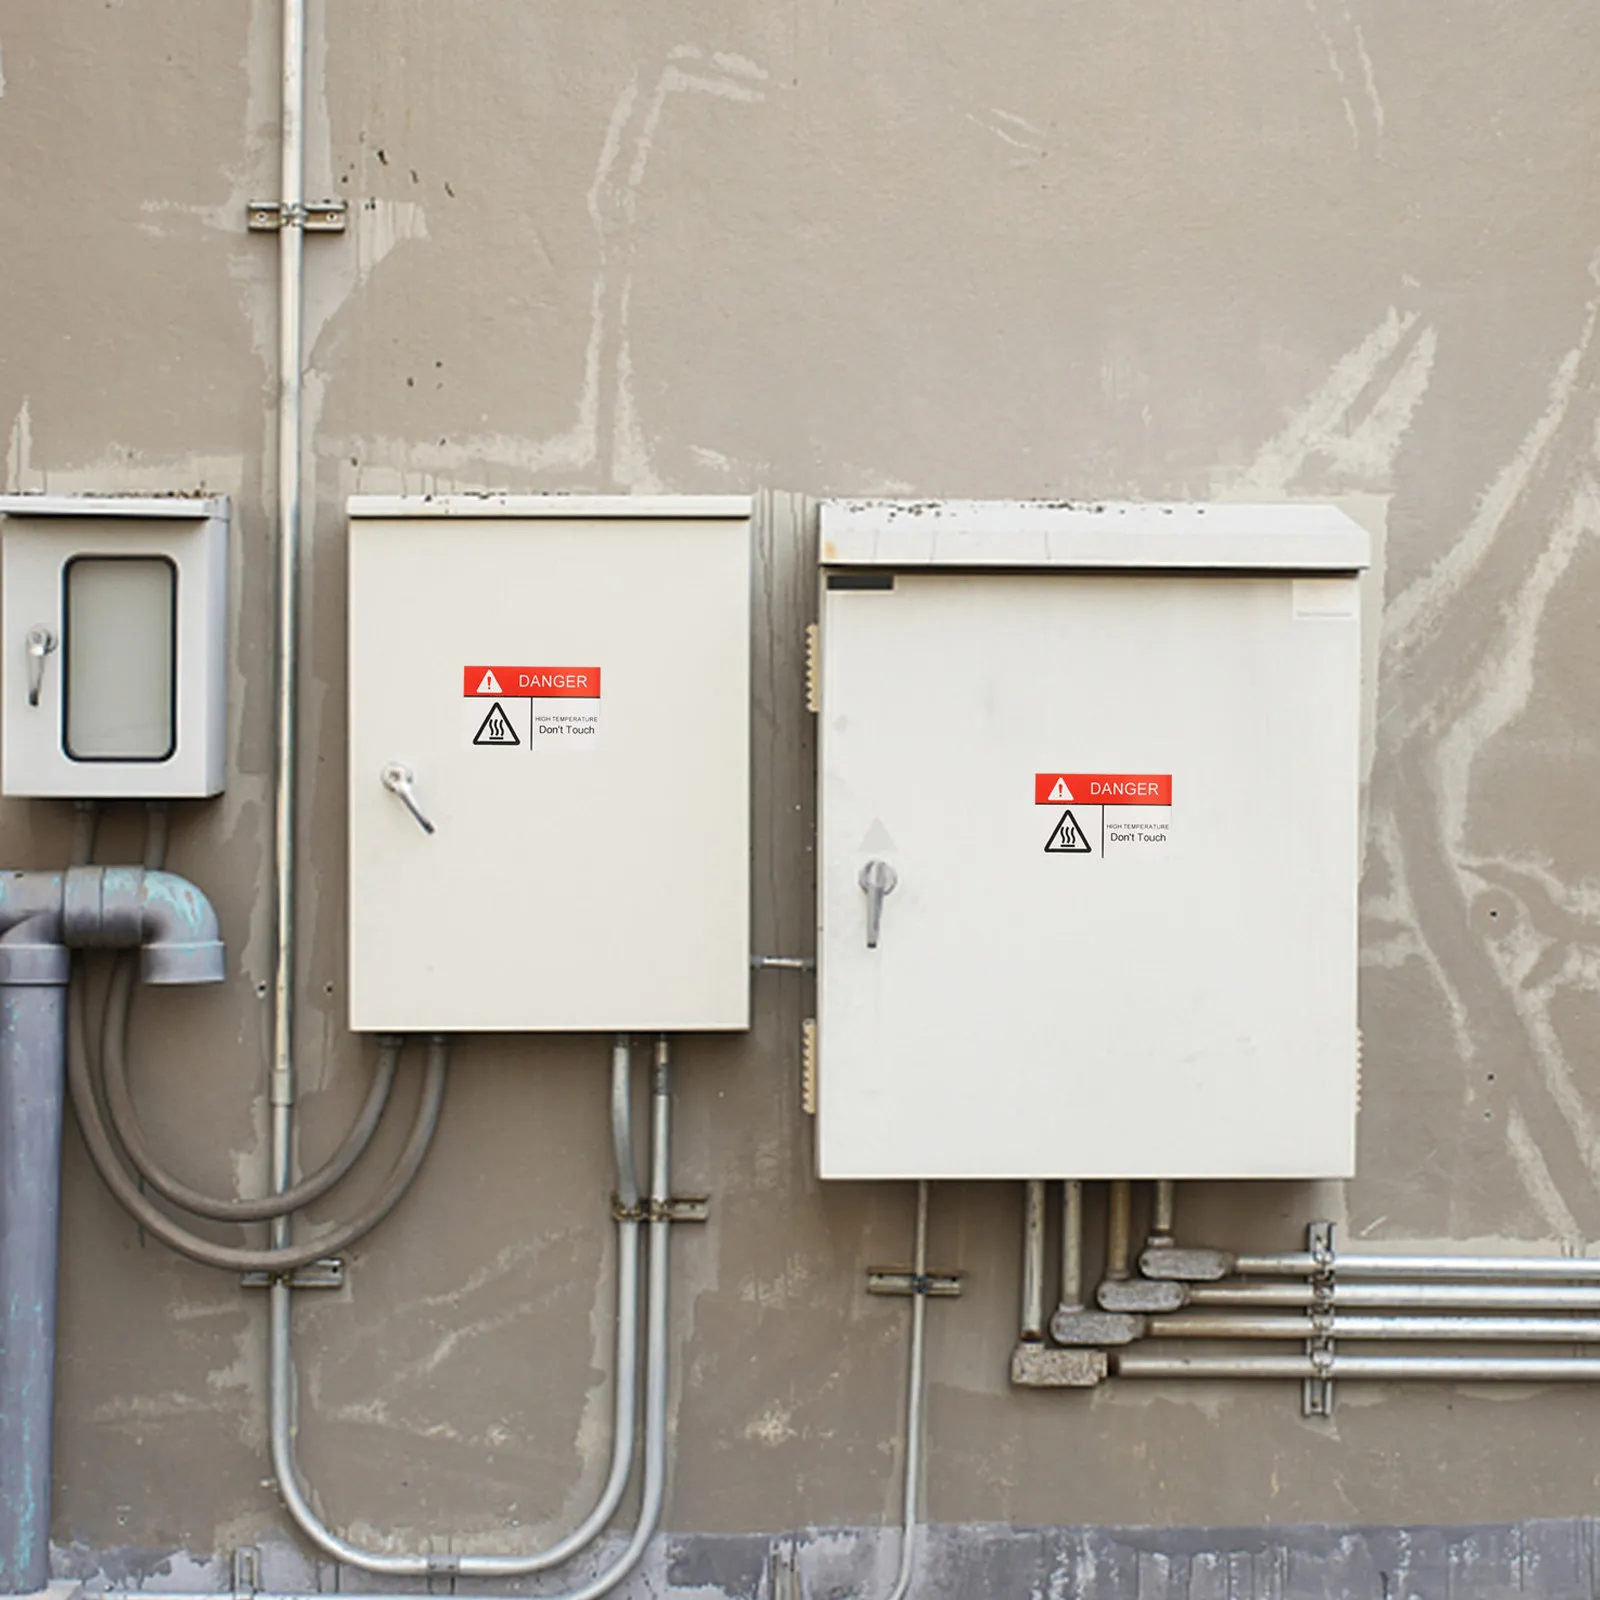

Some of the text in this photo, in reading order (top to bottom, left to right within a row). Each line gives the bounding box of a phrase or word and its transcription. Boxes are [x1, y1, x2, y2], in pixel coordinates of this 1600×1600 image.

[519, 674, 588, 688] DANGER
[539, 725, 595, 734] Don't Touch
[1090, 782, 1159, 796] DANGER
[1110, 832, 1167, 842] Don't Touch
